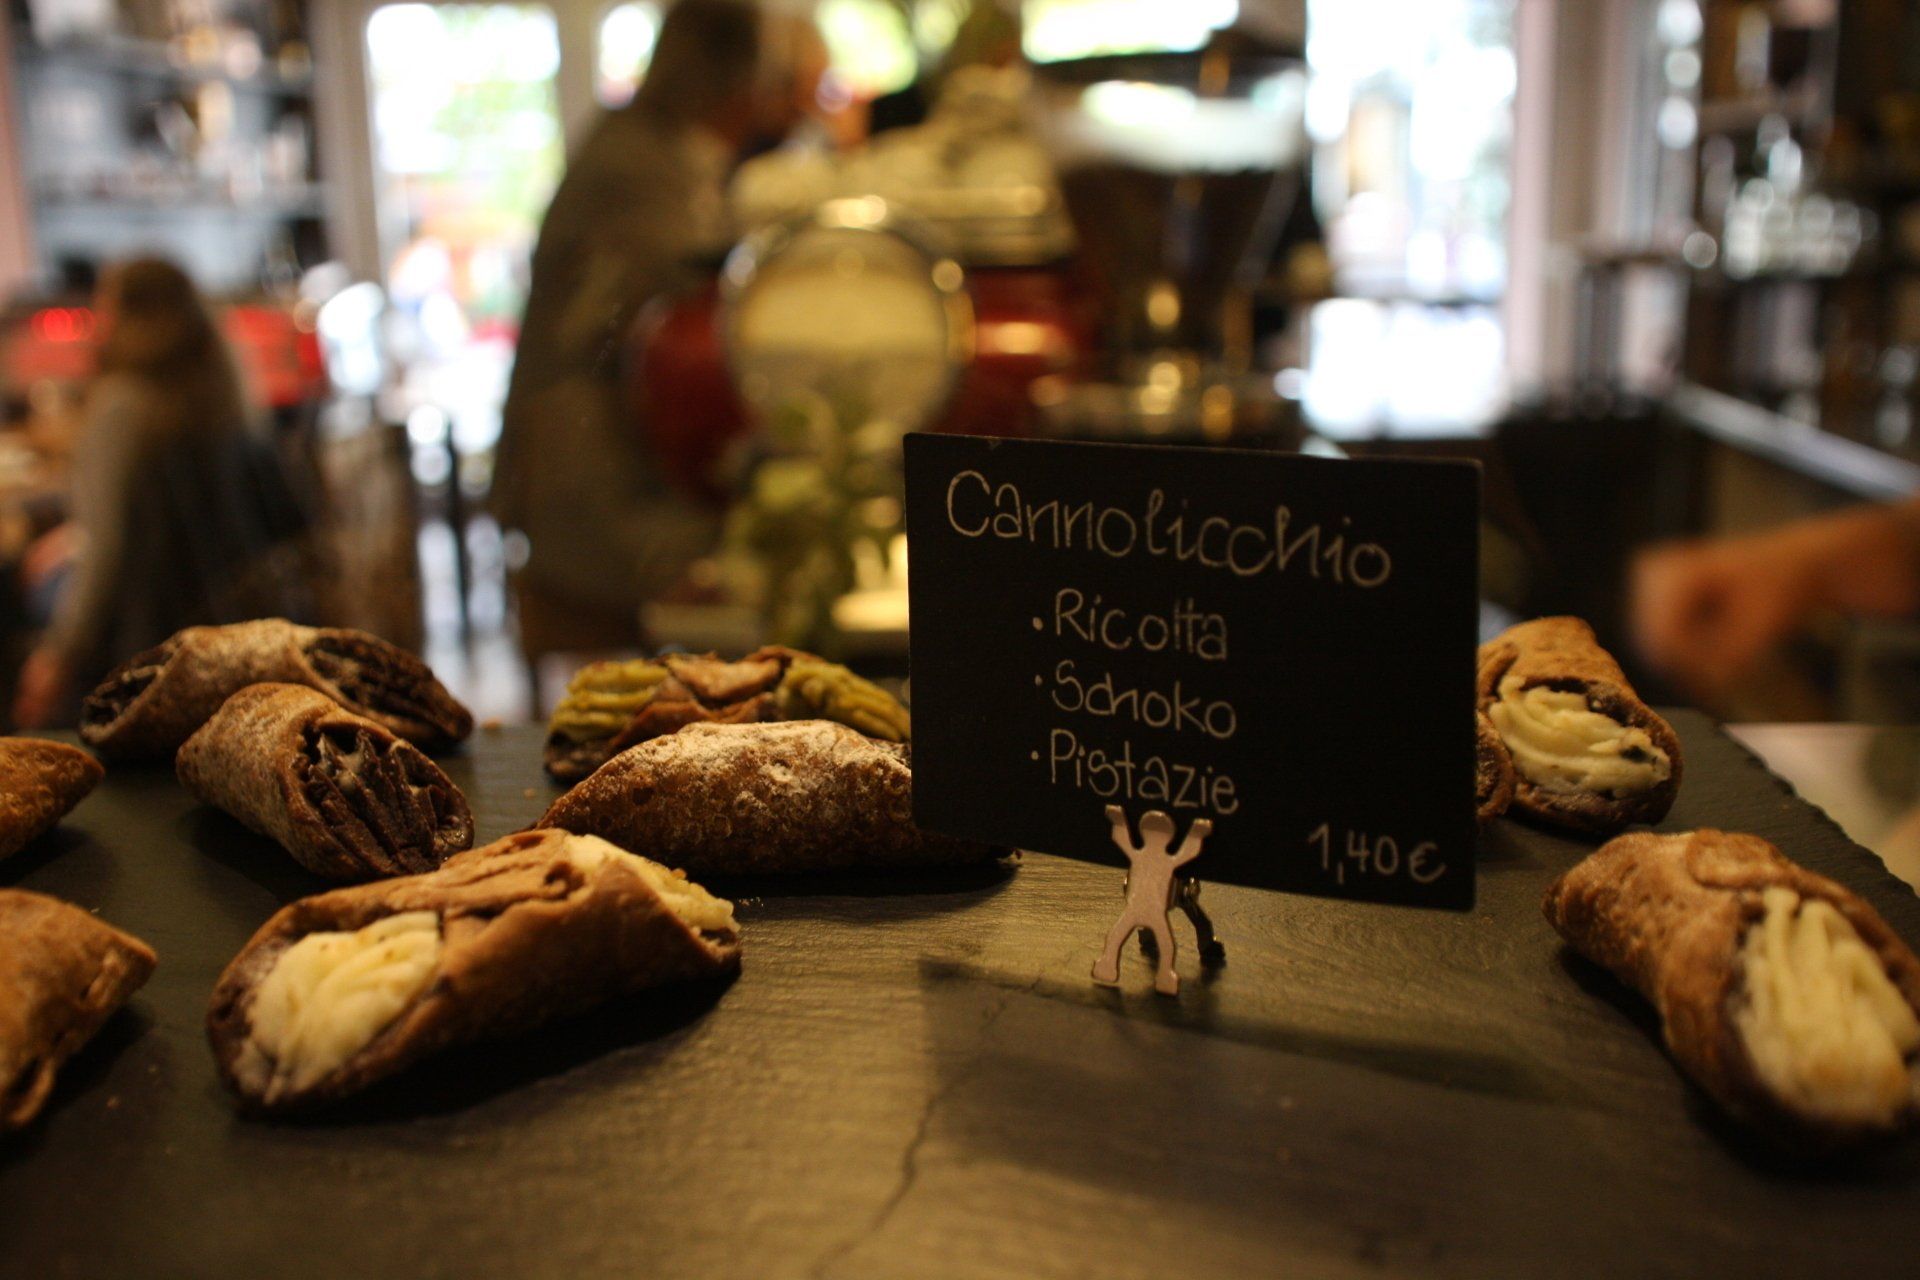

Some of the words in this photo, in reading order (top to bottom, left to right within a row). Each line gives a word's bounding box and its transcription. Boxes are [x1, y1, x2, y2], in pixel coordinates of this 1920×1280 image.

[946, 470, 1391, 587] Cannolicchio
[1055, 588, 1228, 660] Ricotta
[1052, 660, 1237, 738] Schoko
[1051, 728, 1240, 815] Pistazie
